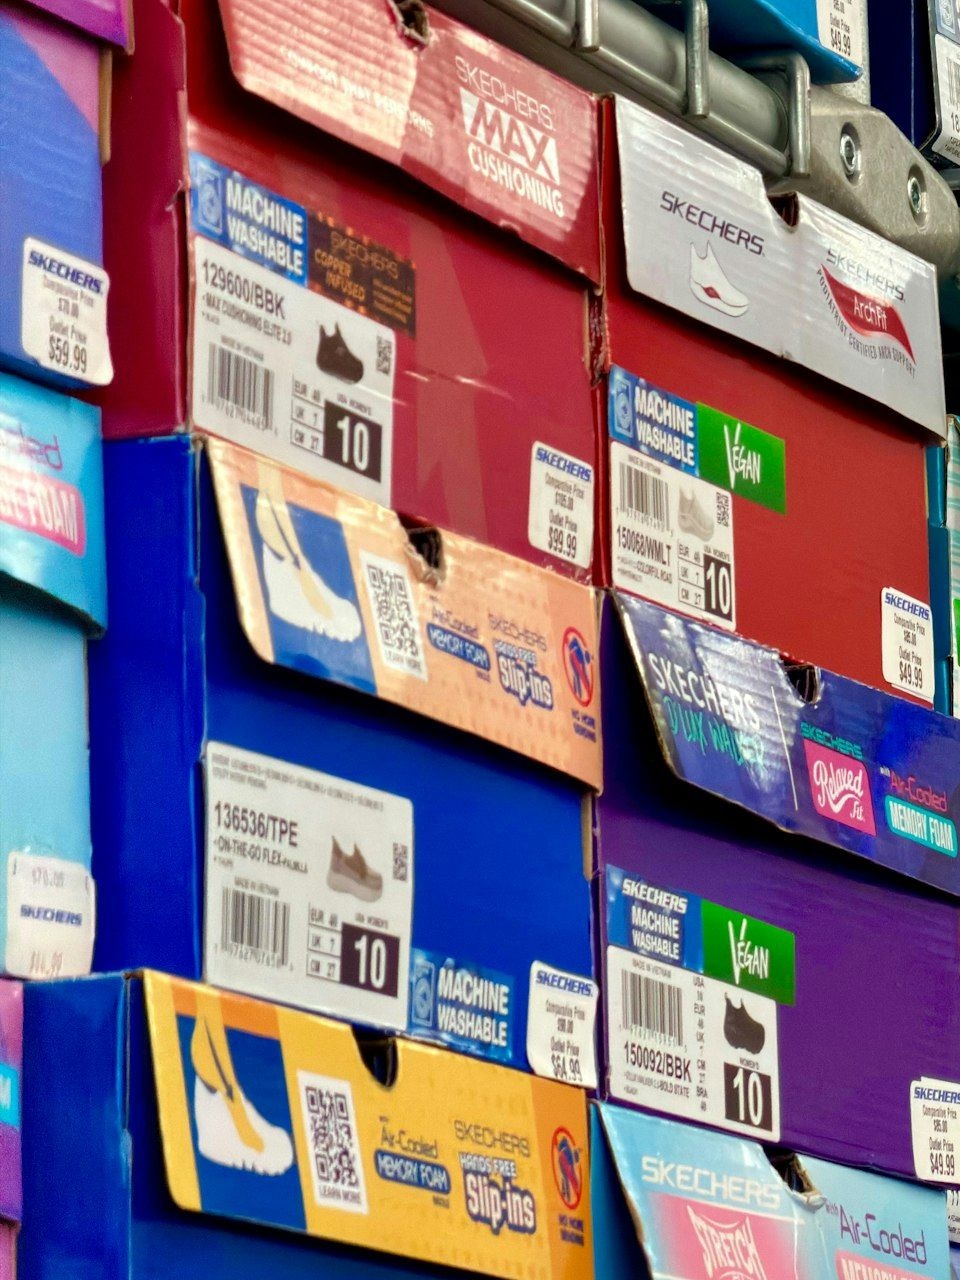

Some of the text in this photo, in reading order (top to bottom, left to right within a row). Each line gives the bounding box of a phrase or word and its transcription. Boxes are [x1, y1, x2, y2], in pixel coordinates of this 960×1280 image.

[455, 55, 556, 132] SKECHERS
[459, 86, 561, 186] MAX
[467, 141, 565, 219] CUSHIONING
[226, 177, 305, 235] MACHINE
[659, 190, 765, 257] SKECHERS
[227, 213, 305, 277] WASHABLE
[314, 249, 352, 280] COPPER
[331, 231, 399, 280] SKECHERS
[28, 250, 104, 294] SKECHERS
[201, 259, 286, 321] 129600/BBK
[826, 248, 906, 303] SKECHERS
[48, 334, 88, 375] $59.99
[634, 385, 695, 438] MACHINE
[337, 414, 370, 472] 10
[535, 446, 592, 483] SKECHERS
[635, 418, 696, 469] WASHABLE
[722, 422, 762, 490] VEGAN
[546, 525, 578, 561] $99.99
[704, 561, 731, 616] 10
[884, 591, 931, 621] SKECHERS
[487, 611, 549, 652] SKECHERS
[648, 652, 762, 730] SKECHERS
[898, 662, 923, 690] $49.99
[800, 721, 863, 761] SKECHERS
[813, 759, 864, 814] Relaxed
[889, 770, 948, 813] Air-Cooled
[213, 801, 299, 849] 136536/TPE
[889, 800, 955, 851] MEMORY FOAM
[621, 878, 688, 914] SKECHERS
[631, 904, 680, 940] MACHINE
[631, 929, 680, 961] WASHABLE
[354, 934, 388, 989] 10
[727, 917, 770, 985] VEGAN
[437, 967, 510, 1015] MACHINE
[535, 969, 594, 997] SKECHERS
[437, 1007, 508, 1048] WASHABLE
[623, 1040, 692, 1084] 150092/BBK
[733, 1066, 762, 1127] 10
[943, 1109, 958, 1121] Price
[453, 1119, 531, 1158] SKECHERS
[940, 1141, 954, 1154] Price
[417, 1165, 449, 1191] FOAM
[490, 1157, 518, 1178] FREE
[641, 1154, 782, 1210] SKECHERS
[929, 1152, 956, 1178] $49.99
[465, 1170, 537, 1234] Slip-ins
[839, 1203, 929, 1266] Air-Cooled
